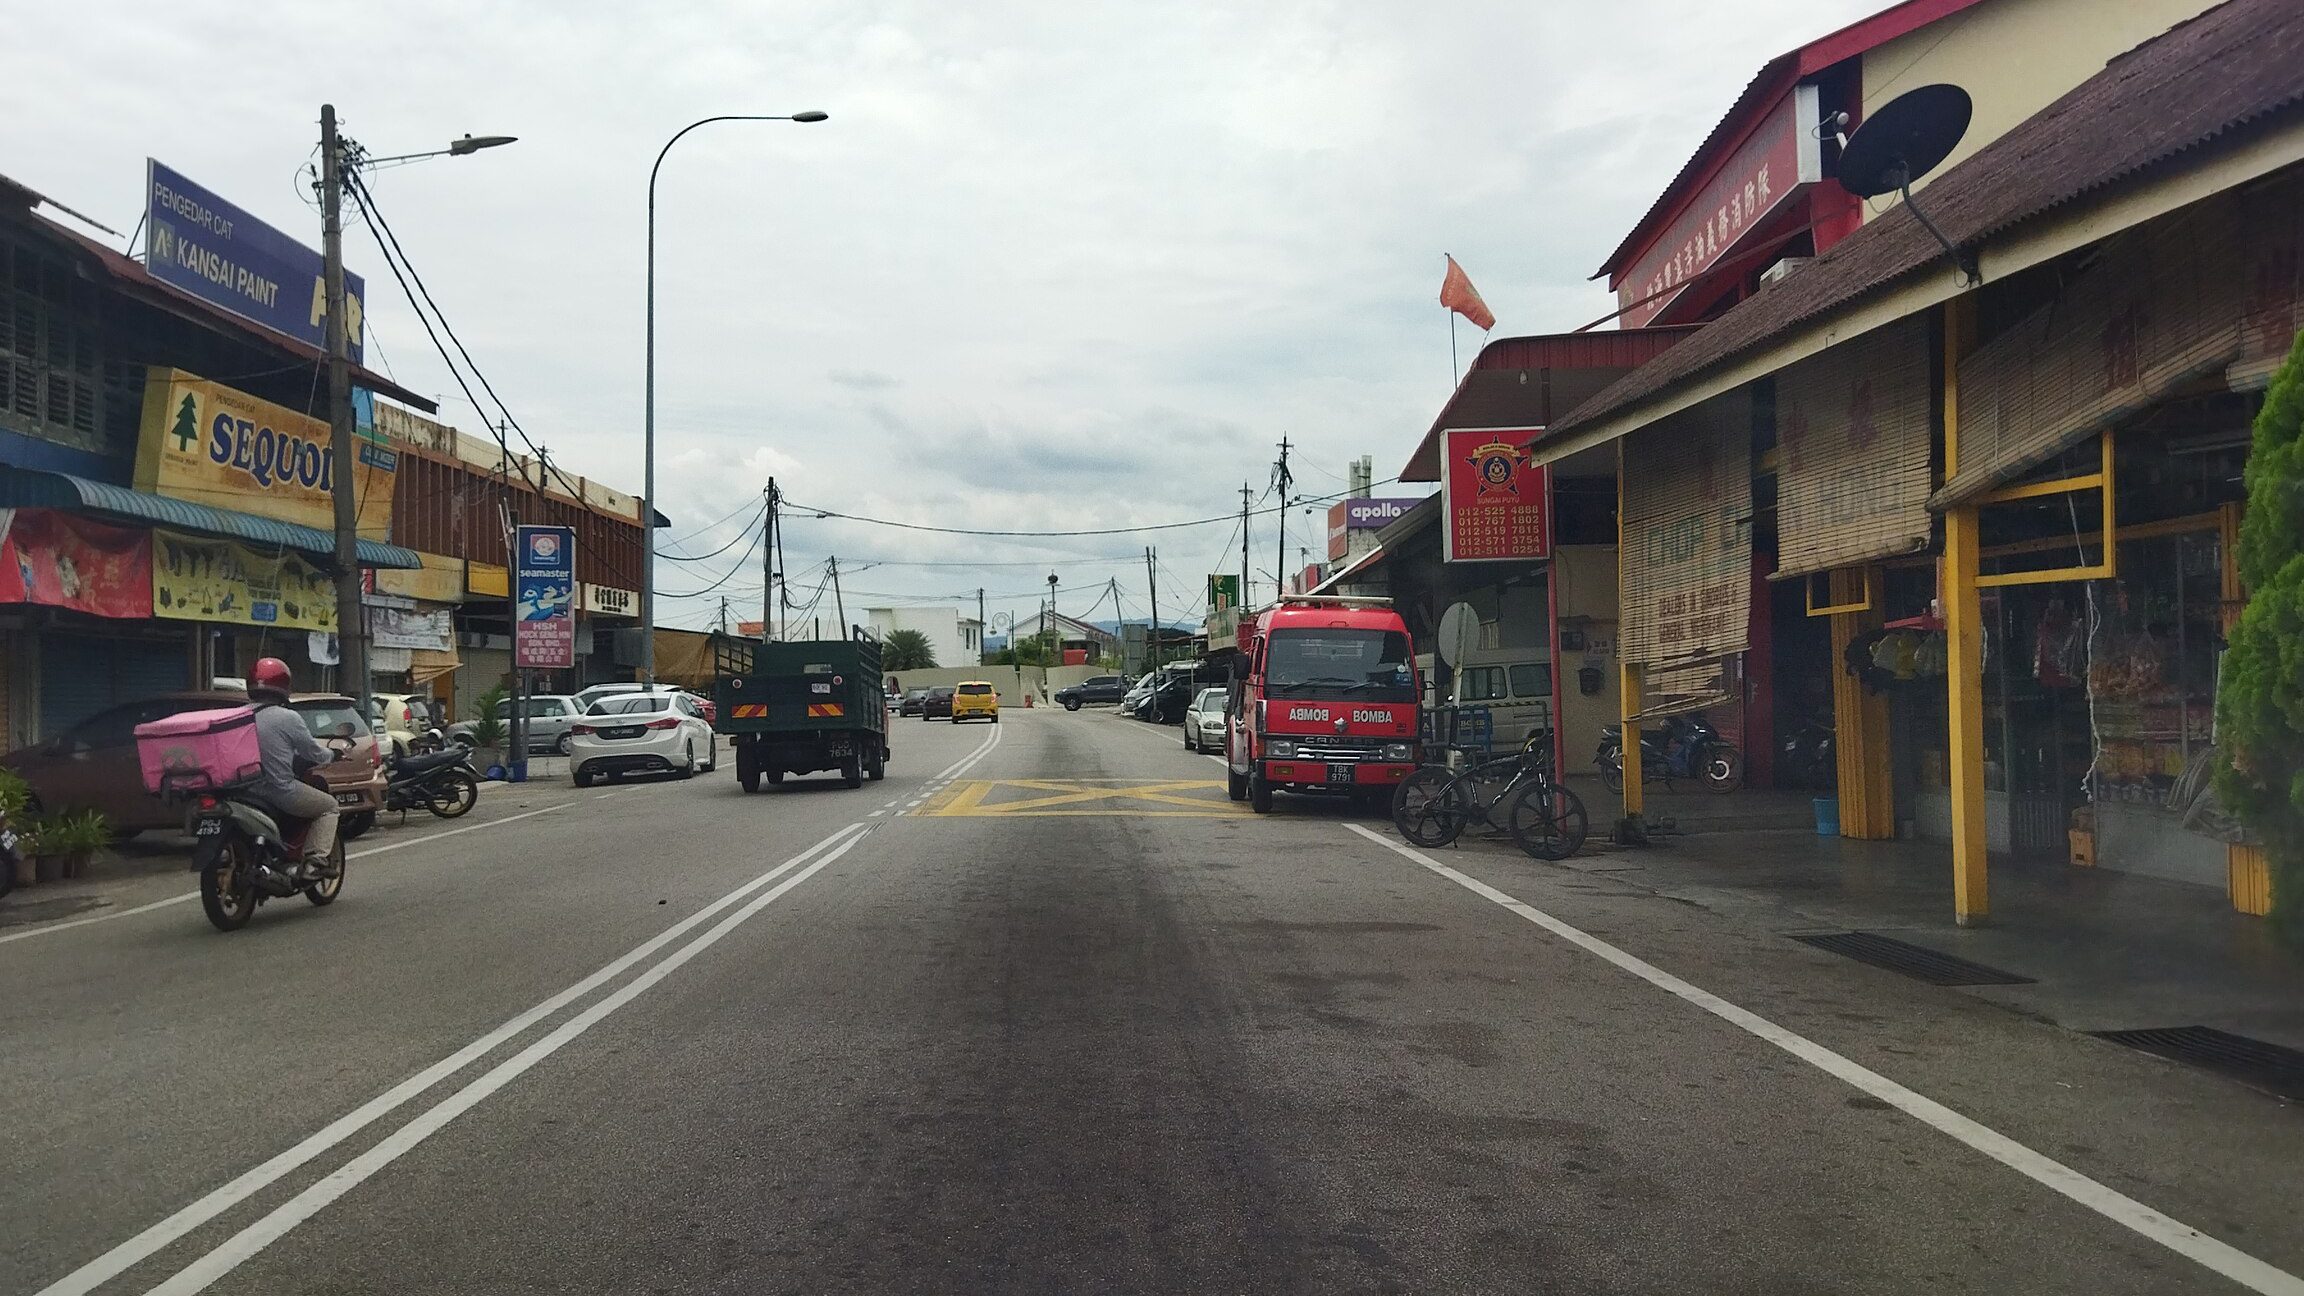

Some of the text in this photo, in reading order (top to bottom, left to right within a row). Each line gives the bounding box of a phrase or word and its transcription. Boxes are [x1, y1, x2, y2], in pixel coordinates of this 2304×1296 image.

[154, 183, 234, 241] PENGEDAR CAT
[177, 236, 279, 309] KANSAI PAINT
[1477, 496, 1501, 505] SUNGAI
[1351, 502, 1402, 522] apollo
[1458, 505, 1540, 516] 012-525 4888
[1458, 515, 1540, 526] 012-767 1802
[1458, 525, 1540, 536] 012-519 7815
[1458, 535, 1540, 546] 012-571 3754
[1458, 545, 1540, 556] 012-511 0254
[519, 569, 570, 578] seamaster
[533, 622, 557, 631] HSH
[1353, 710, 1393, 723] BOMBA
[1331, 773, 1351, 782] 9791
